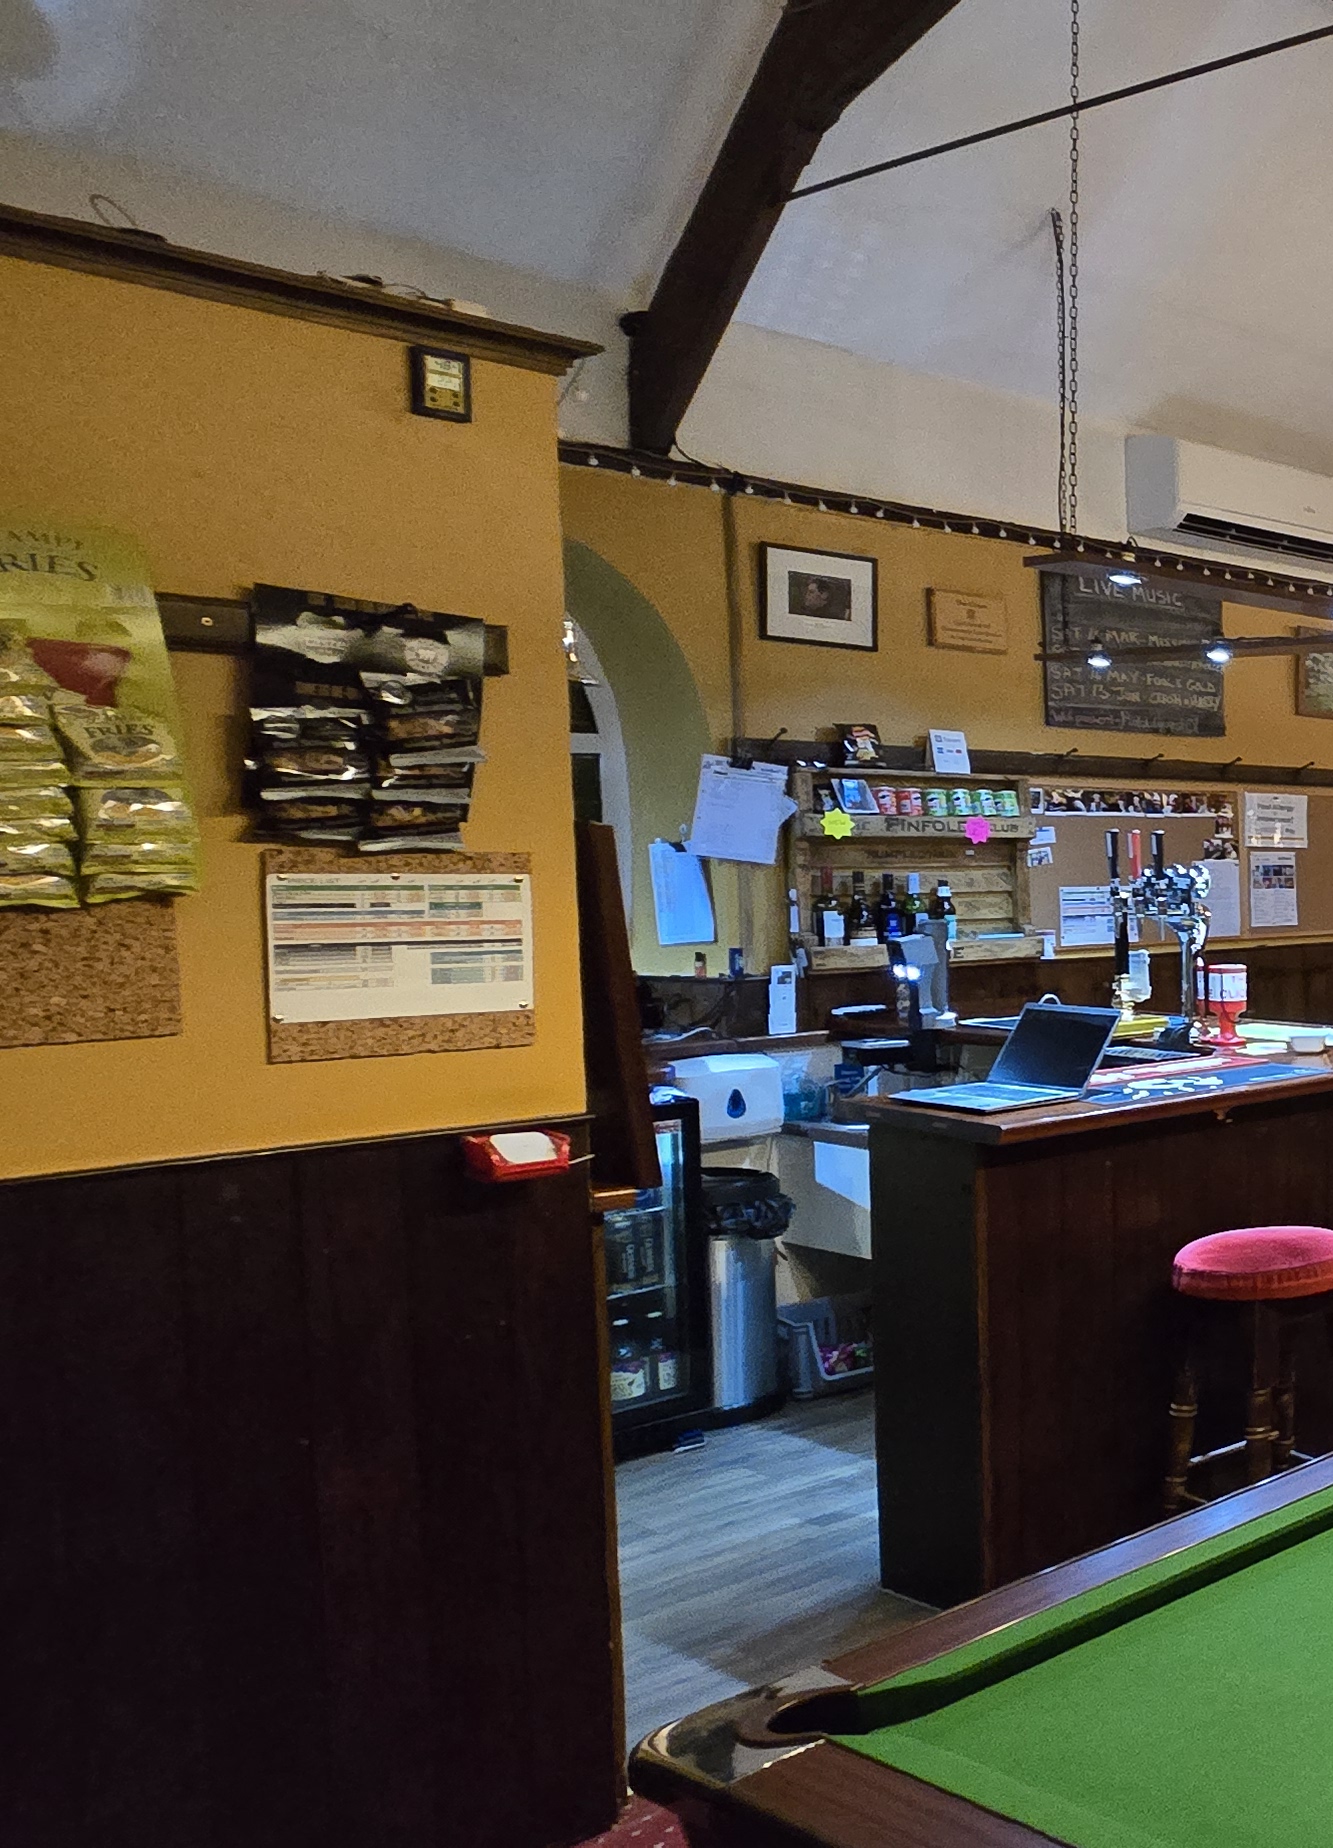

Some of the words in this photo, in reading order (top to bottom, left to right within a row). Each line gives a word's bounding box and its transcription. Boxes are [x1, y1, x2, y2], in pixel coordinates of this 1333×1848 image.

[0, 552, 98, 581] RIES
[1078, 576, 1126, 600] LIVE
[1132, 587, 1183, 607] MUSIC
[1050, 664, 1083, 680] SAT
[1050, 684, 1085, 700] SAT
[83, 723, 157, 739] FRIES
